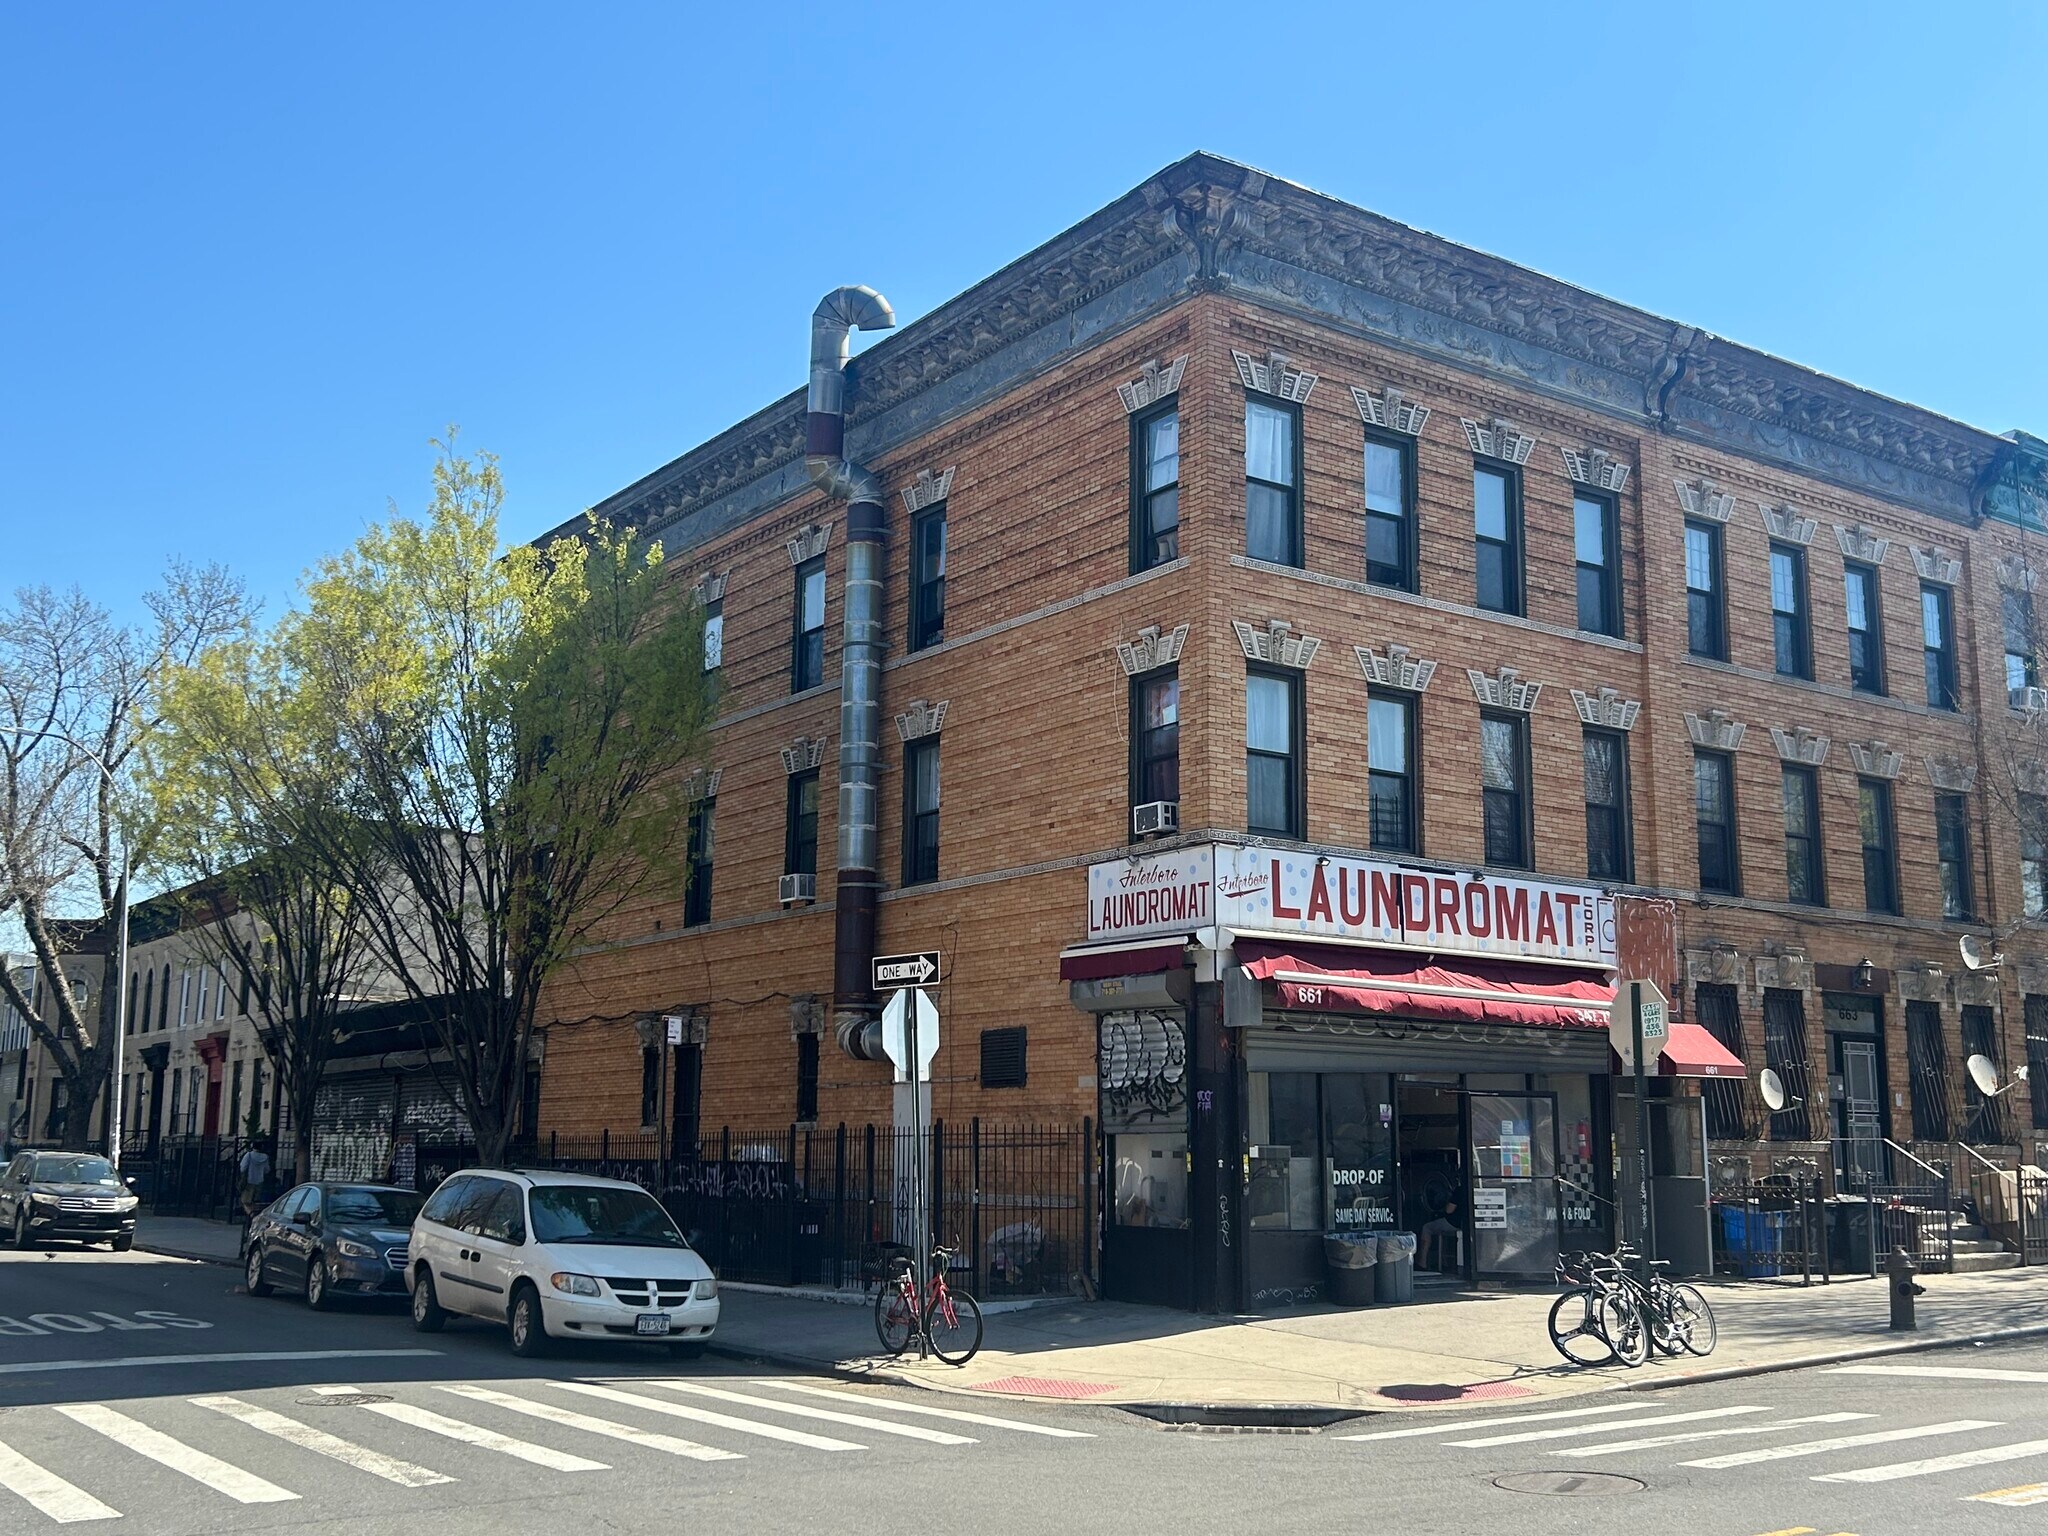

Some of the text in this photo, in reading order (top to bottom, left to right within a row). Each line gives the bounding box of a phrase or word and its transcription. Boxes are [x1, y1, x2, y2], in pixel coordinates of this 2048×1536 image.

[1119, 864, 1179, 888] Interboro
[1090, 881, 1210, 932] LAUNDROMAT
[1271, 859, 1580, 947] LAUNDROMAT
[882, 962, 929, 979] ONE WAY
[1298, 986, 1322, 1004] 661
[1838, 1008, 1858, 1021] 663
[1705, 1065, 1719, 1075] 661
[1335, 1208, 1354, 1223] SAME
[1354, 1208, 1367, 1223] DAY
[1574, 1207, 1591, 1220] FOLD
